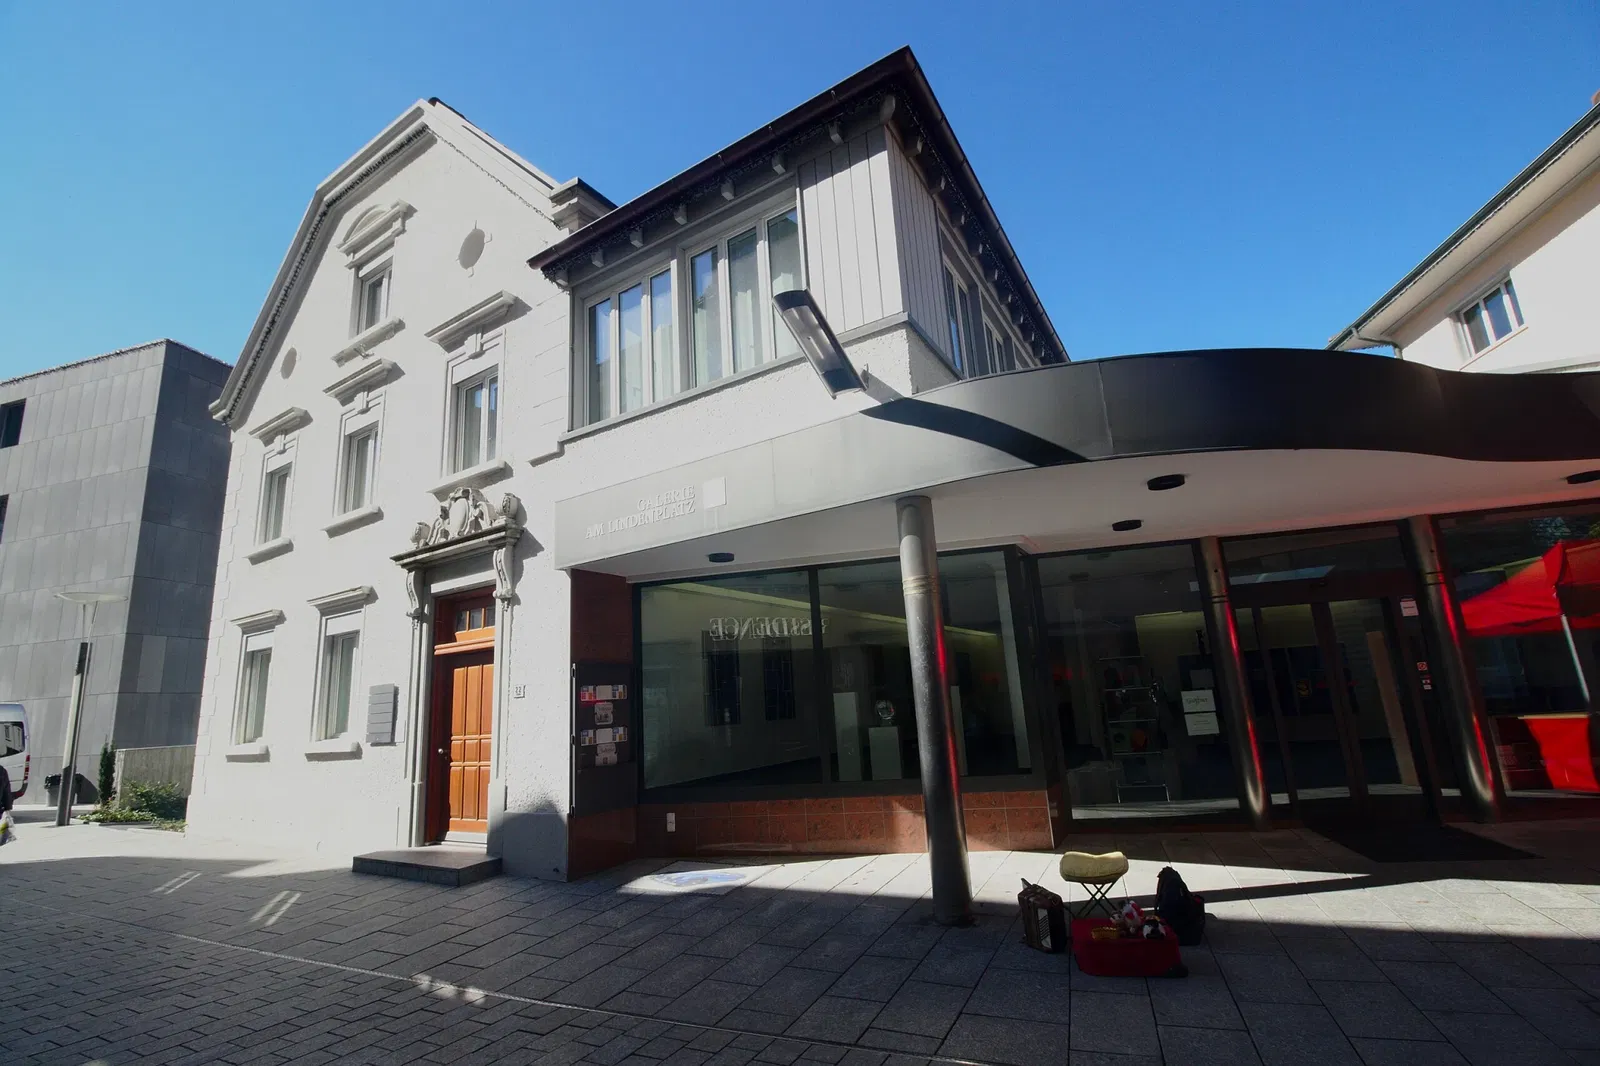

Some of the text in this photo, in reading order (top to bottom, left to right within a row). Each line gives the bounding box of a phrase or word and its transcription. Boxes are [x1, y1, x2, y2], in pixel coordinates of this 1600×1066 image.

[637, 485, 696, 512] GALERIE
[585, 500, 696, 539] AM LINDENPLATZ
